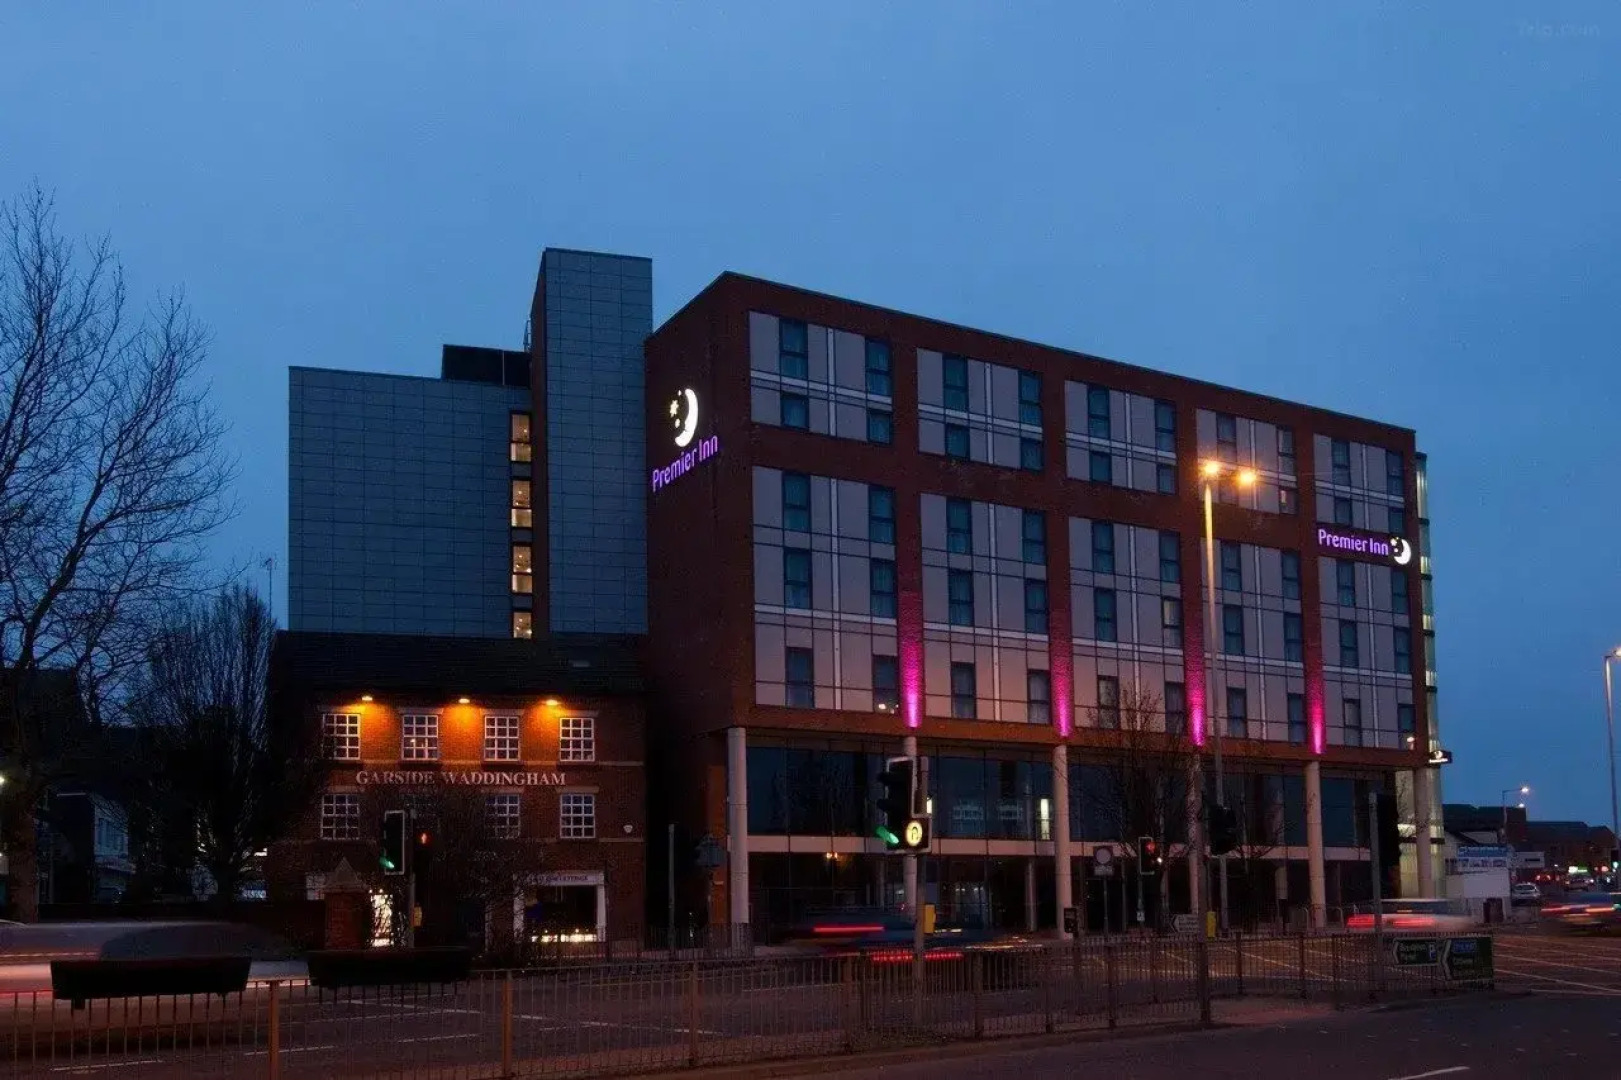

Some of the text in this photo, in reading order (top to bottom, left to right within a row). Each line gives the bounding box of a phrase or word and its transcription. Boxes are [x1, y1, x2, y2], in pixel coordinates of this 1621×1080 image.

[652, 435, 718, 492] Premier Inn
[1318, 529, 1389, 555] Premier Inn
[355, 770, 566, 786] GARSIDE WADDINGHAM
